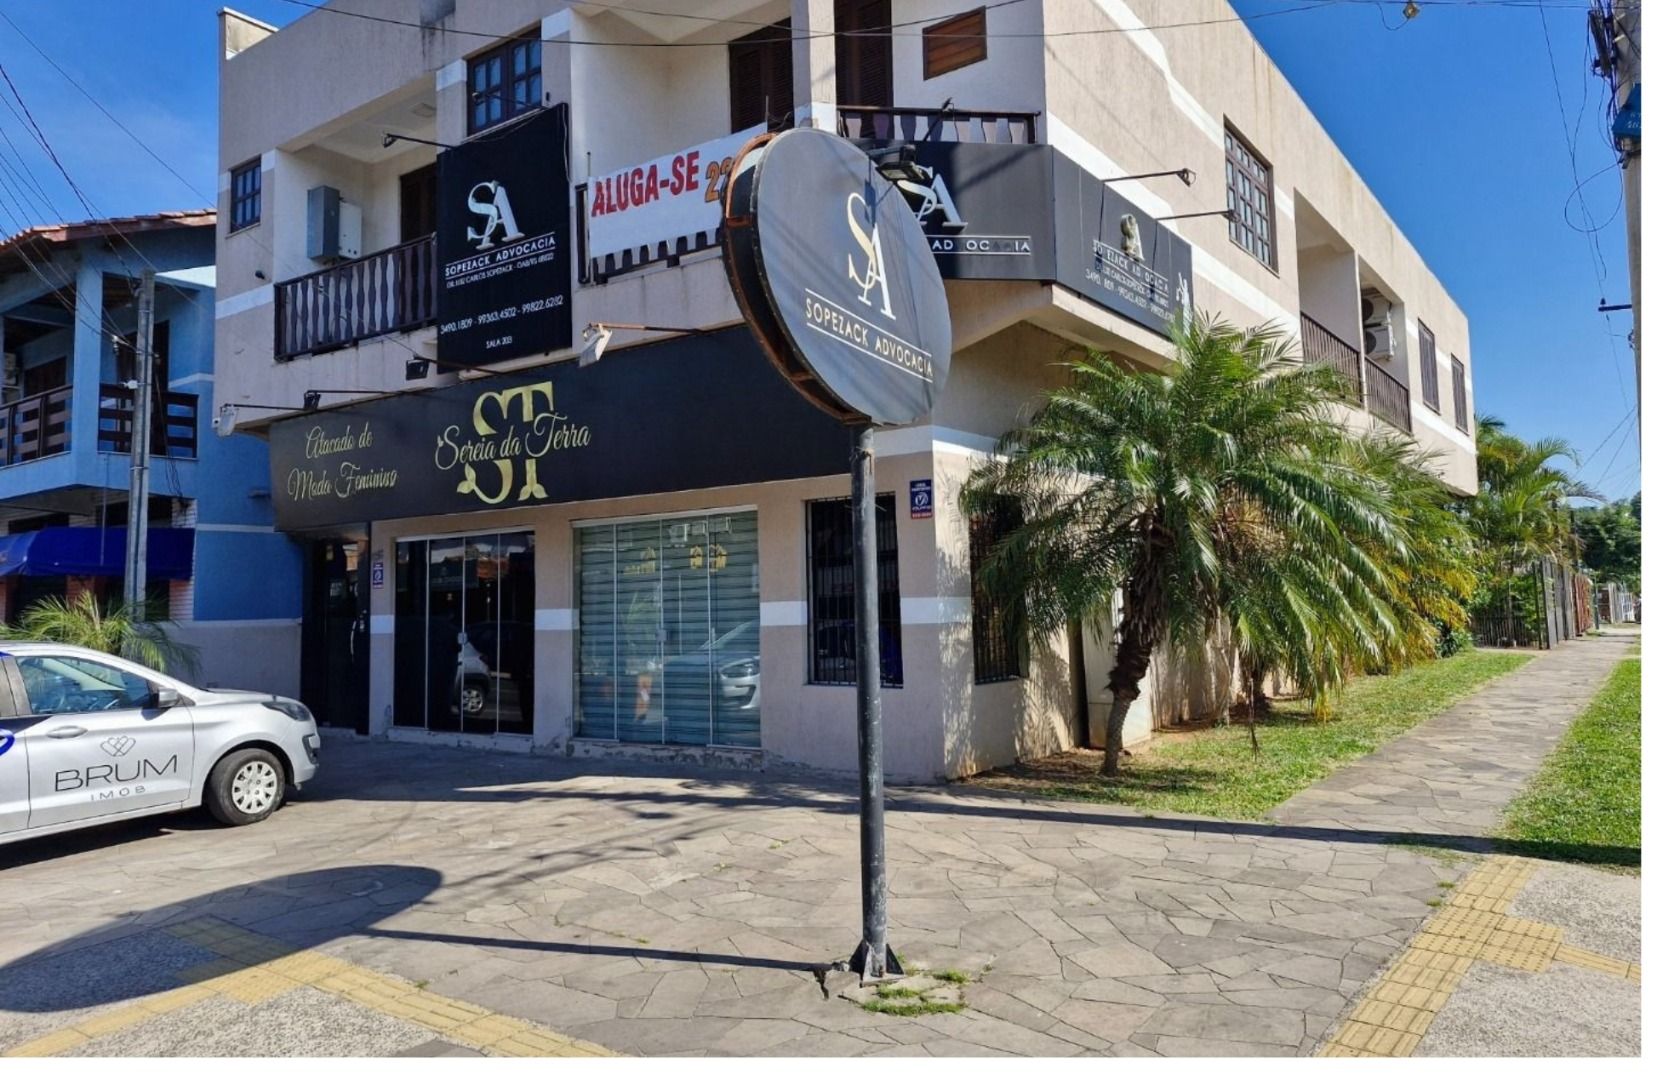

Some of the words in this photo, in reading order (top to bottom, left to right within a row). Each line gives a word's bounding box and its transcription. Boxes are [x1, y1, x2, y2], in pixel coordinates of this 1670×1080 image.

[591, 151, 700, 217] ALUGA-SE
[445, 256, 490, 277] SOPEZACK
[495, 236, 556, 262] ADVOCACIA
[805, 298, 869, 346] SOPEZACK
[875, 336, 933, 377] ADVOCACIA
[306, 425, 354, 459] Atacado
[359, 421, 374, 449] de
[435, 424, 496, 470] Sereia
[500, 425, 522, 458] da
[525, 412, 592, 458] Terra
[55, 754, 177, 792] BRUM
[91, 785, 146, 801] IMOB
